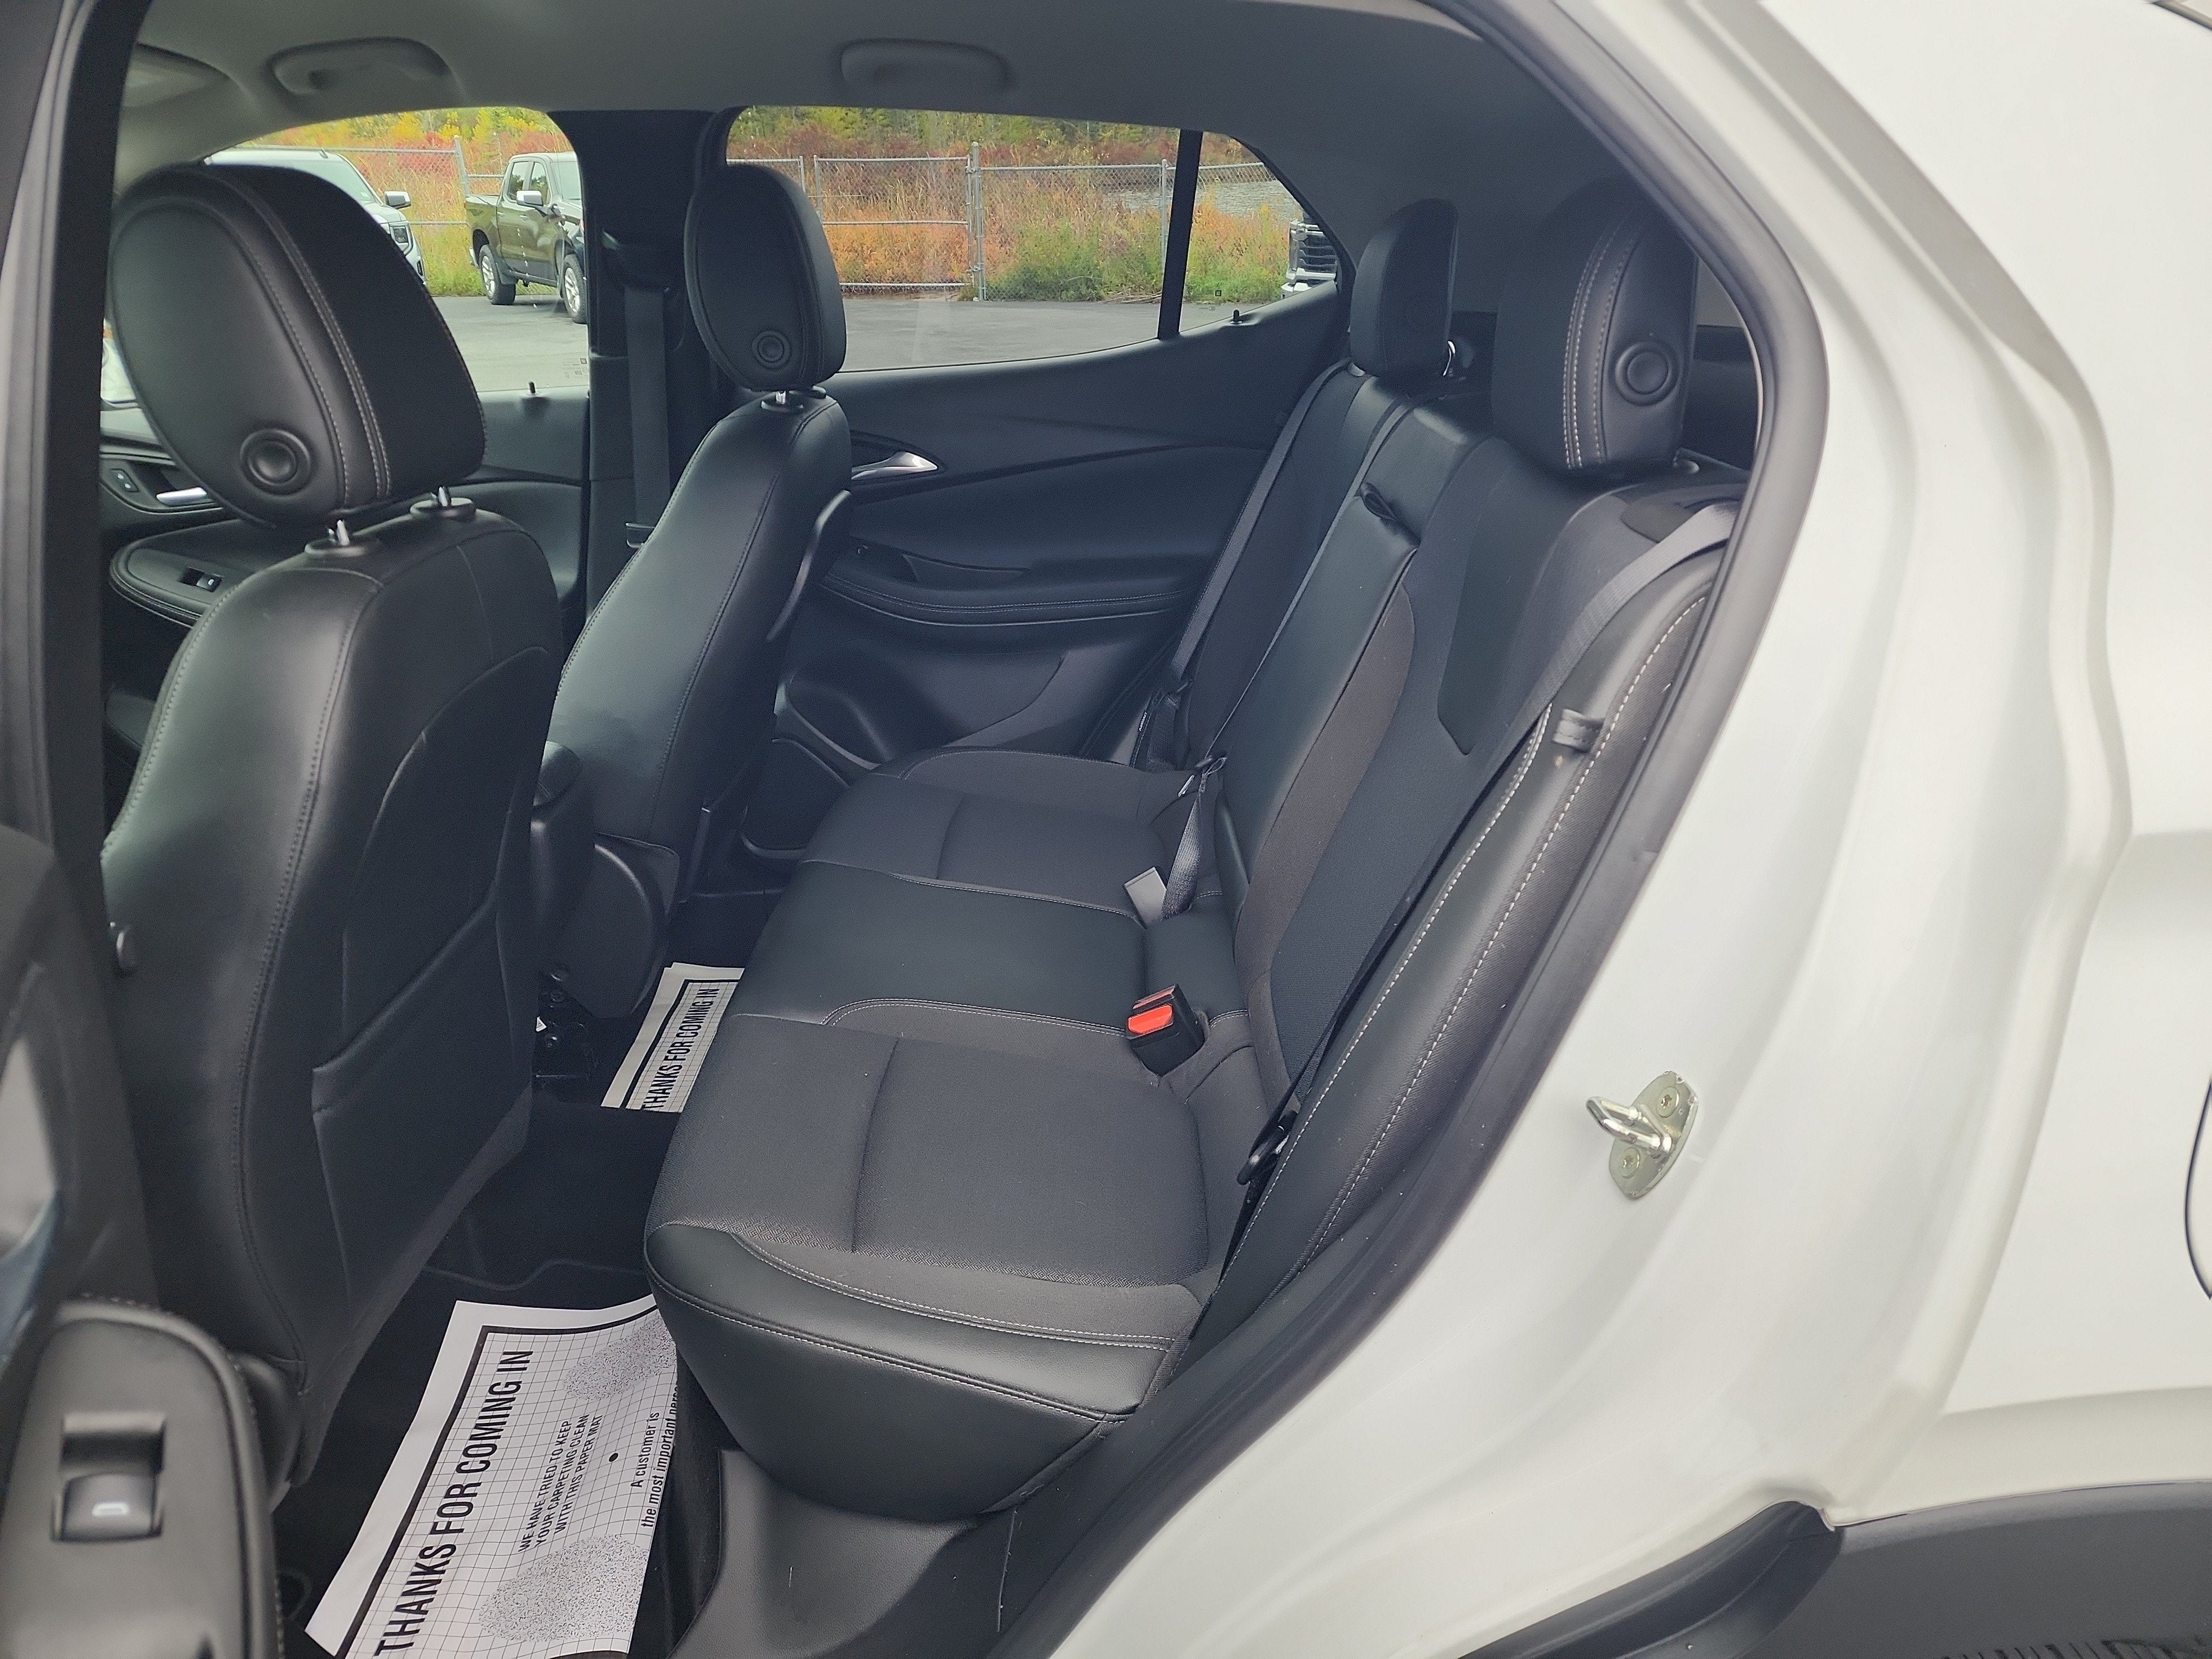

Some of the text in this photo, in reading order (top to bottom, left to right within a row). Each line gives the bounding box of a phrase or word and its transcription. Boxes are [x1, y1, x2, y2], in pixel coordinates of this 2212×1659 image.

[640, 988, 720, 1109] THANKS FOR COMING IN
[374, 1350, 533, 1656] THANKS FOR COMING IN
[518, 1421, 572, 1552] WE HAVE TRIED TO KEEP
[535, 1413, 589, 1548] YOUR CARPETING CLEAN
[554, 1414, 603, 1535] WITH THIS PAPER MAT
[630, 1412, 660, 1488] A customer is
[649, 1475, 664, 1504] most
[653, 1418, 676, 1472] important
[641, 1508, 656, 1527] the
